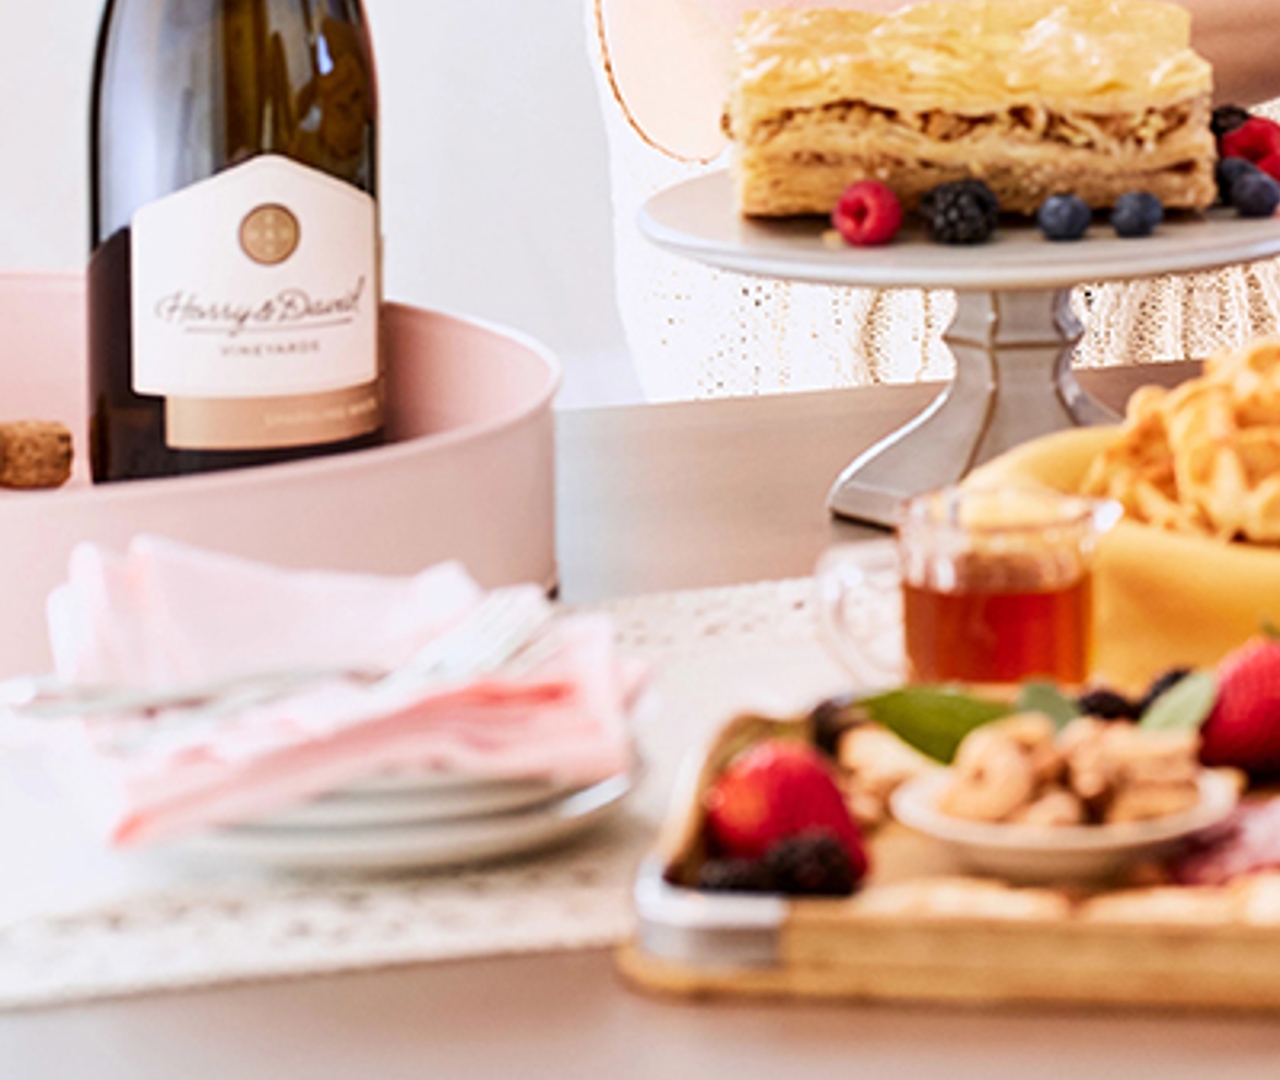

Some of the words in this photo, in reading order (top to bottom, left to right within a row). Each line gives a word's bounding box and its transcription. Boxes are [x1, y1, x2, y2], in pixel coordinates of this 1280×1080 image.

[154, 290, 252, 337] Harry
[276, 274, 366, 322] David
[219, 340, 320, 357] VINEYARDS
